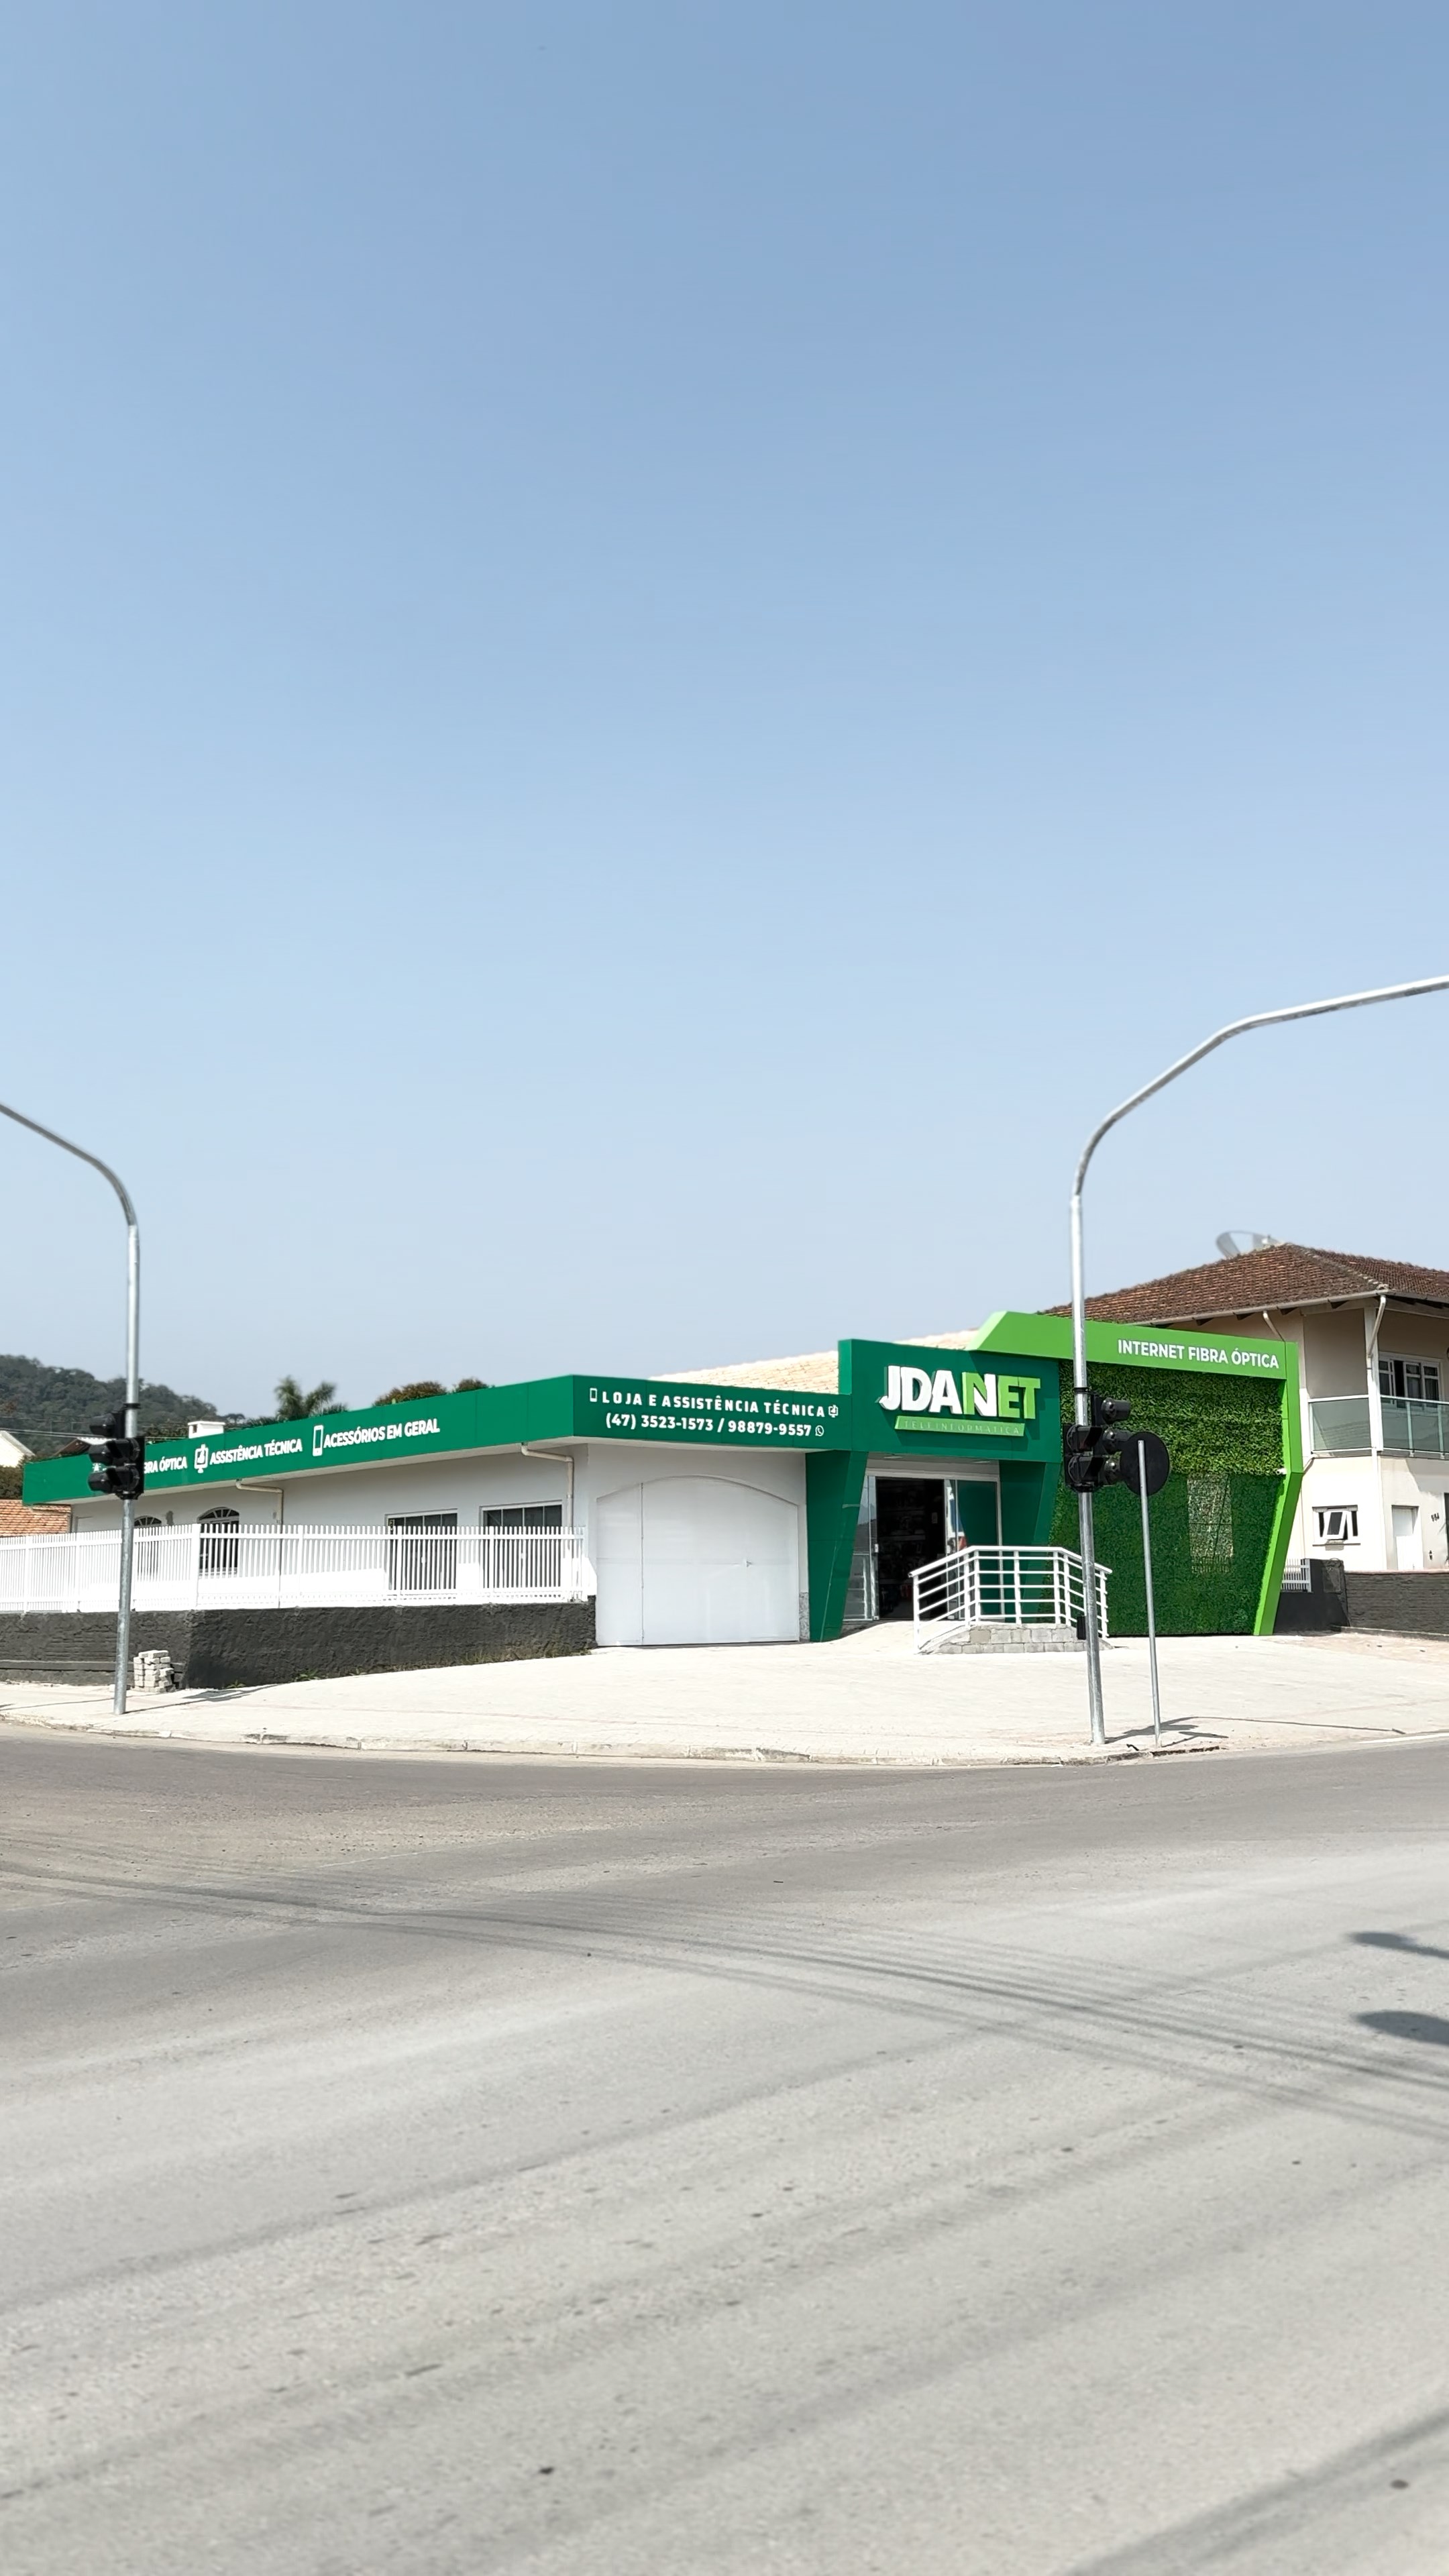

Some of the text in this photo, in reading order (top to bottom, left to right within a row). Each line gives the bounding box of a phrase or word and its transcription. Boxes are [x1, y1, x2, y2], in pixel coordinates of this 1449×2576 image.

[1118, 1339, 1279, 1368] INTERNET FIBRA ÓPTICA
[602, 1391, 825, 1417] LOJA E ASSISTÊNCIA TÉCNICA
[879, 1365, 1041, 1419] JDANET
[323, 1418, 440, 1448] ACESSÓRIOS EM GERAL
[606, 1413, 636, 1430] (47)
[641, 1415, 714, 1431] 3523-1573
[729, 1421, 812, 1436] 98879-9557
[144, 1456, 188, 1474] BRA ÓPTICA
[209, 1439, 303, 1465] ASSISTÊNCIA TÉCNICA
